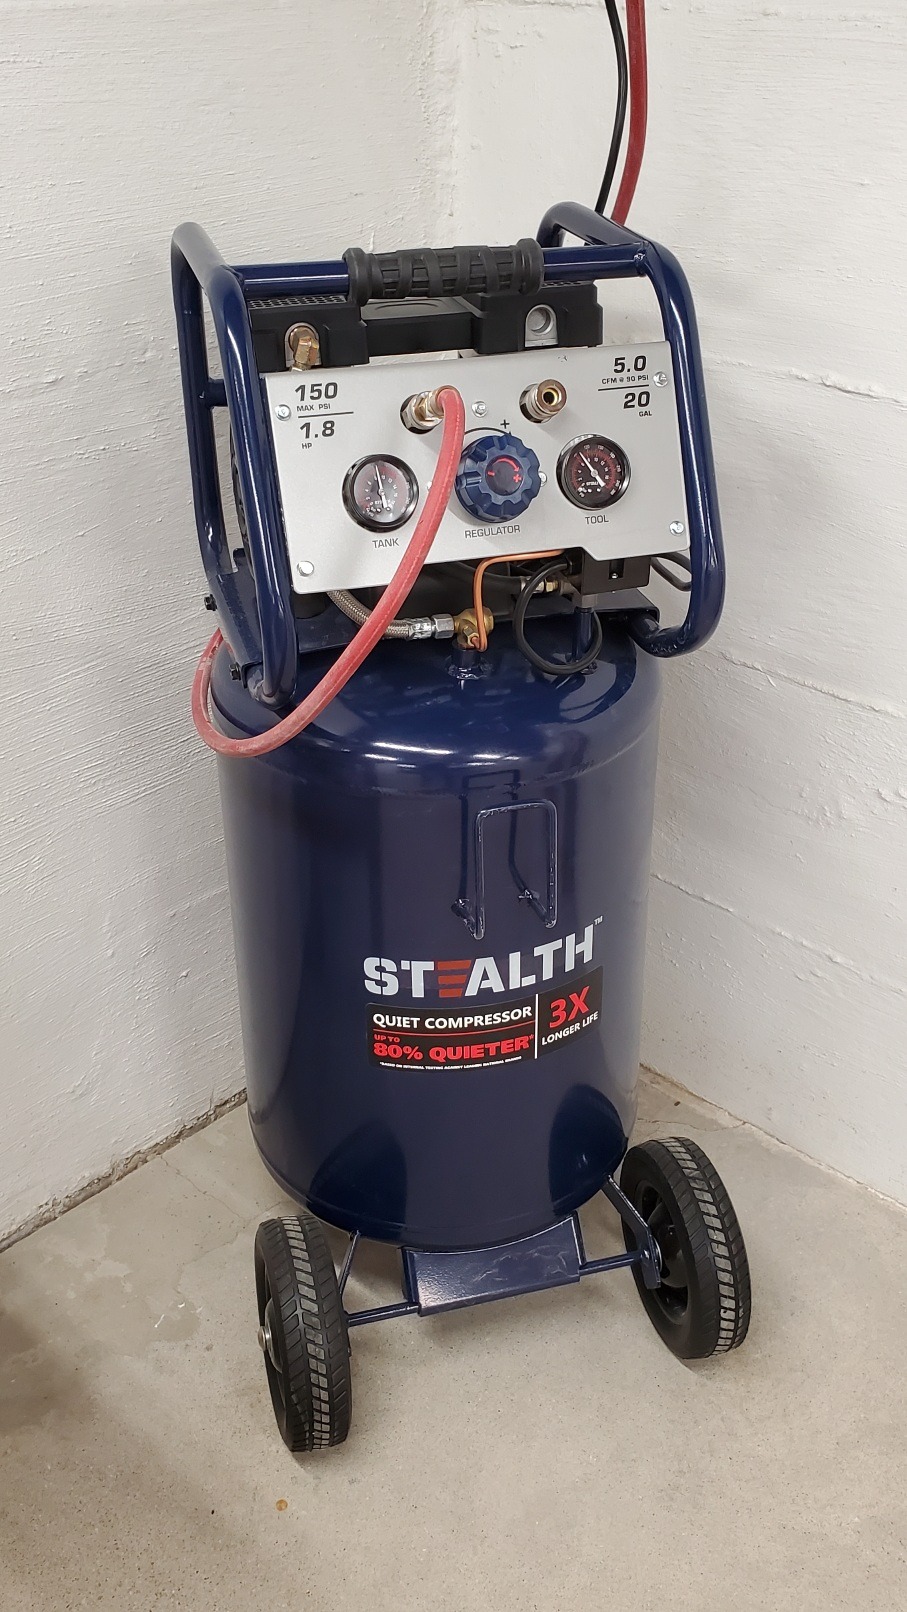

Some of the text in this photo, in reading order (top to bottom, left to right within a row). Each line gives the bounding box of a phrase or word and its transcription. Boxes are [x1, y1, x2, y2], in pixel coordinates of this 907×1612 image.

[613, 355, 647, 373] 5.0
[295, 382, 338, 402] 150
[623, 391, 650, 409] 20
[300, 420, 335, 439] 1.8
[585, 514, 609, 525] TOOL
[465, 525, 521, 539] REGULATOR
[372, 538, 399, 549] TANK
[363, 923, 594, 998] STEALTH
[549, 985, 590, 1029] 3X
[372, 1006, 532, 1029] QUIET COMPRESSOR
[374, 1033, 387, 1041] UP
[541, 1011, 599, 1046] LONGER LIFE
[373, 1042, 424, 1060] 80%
